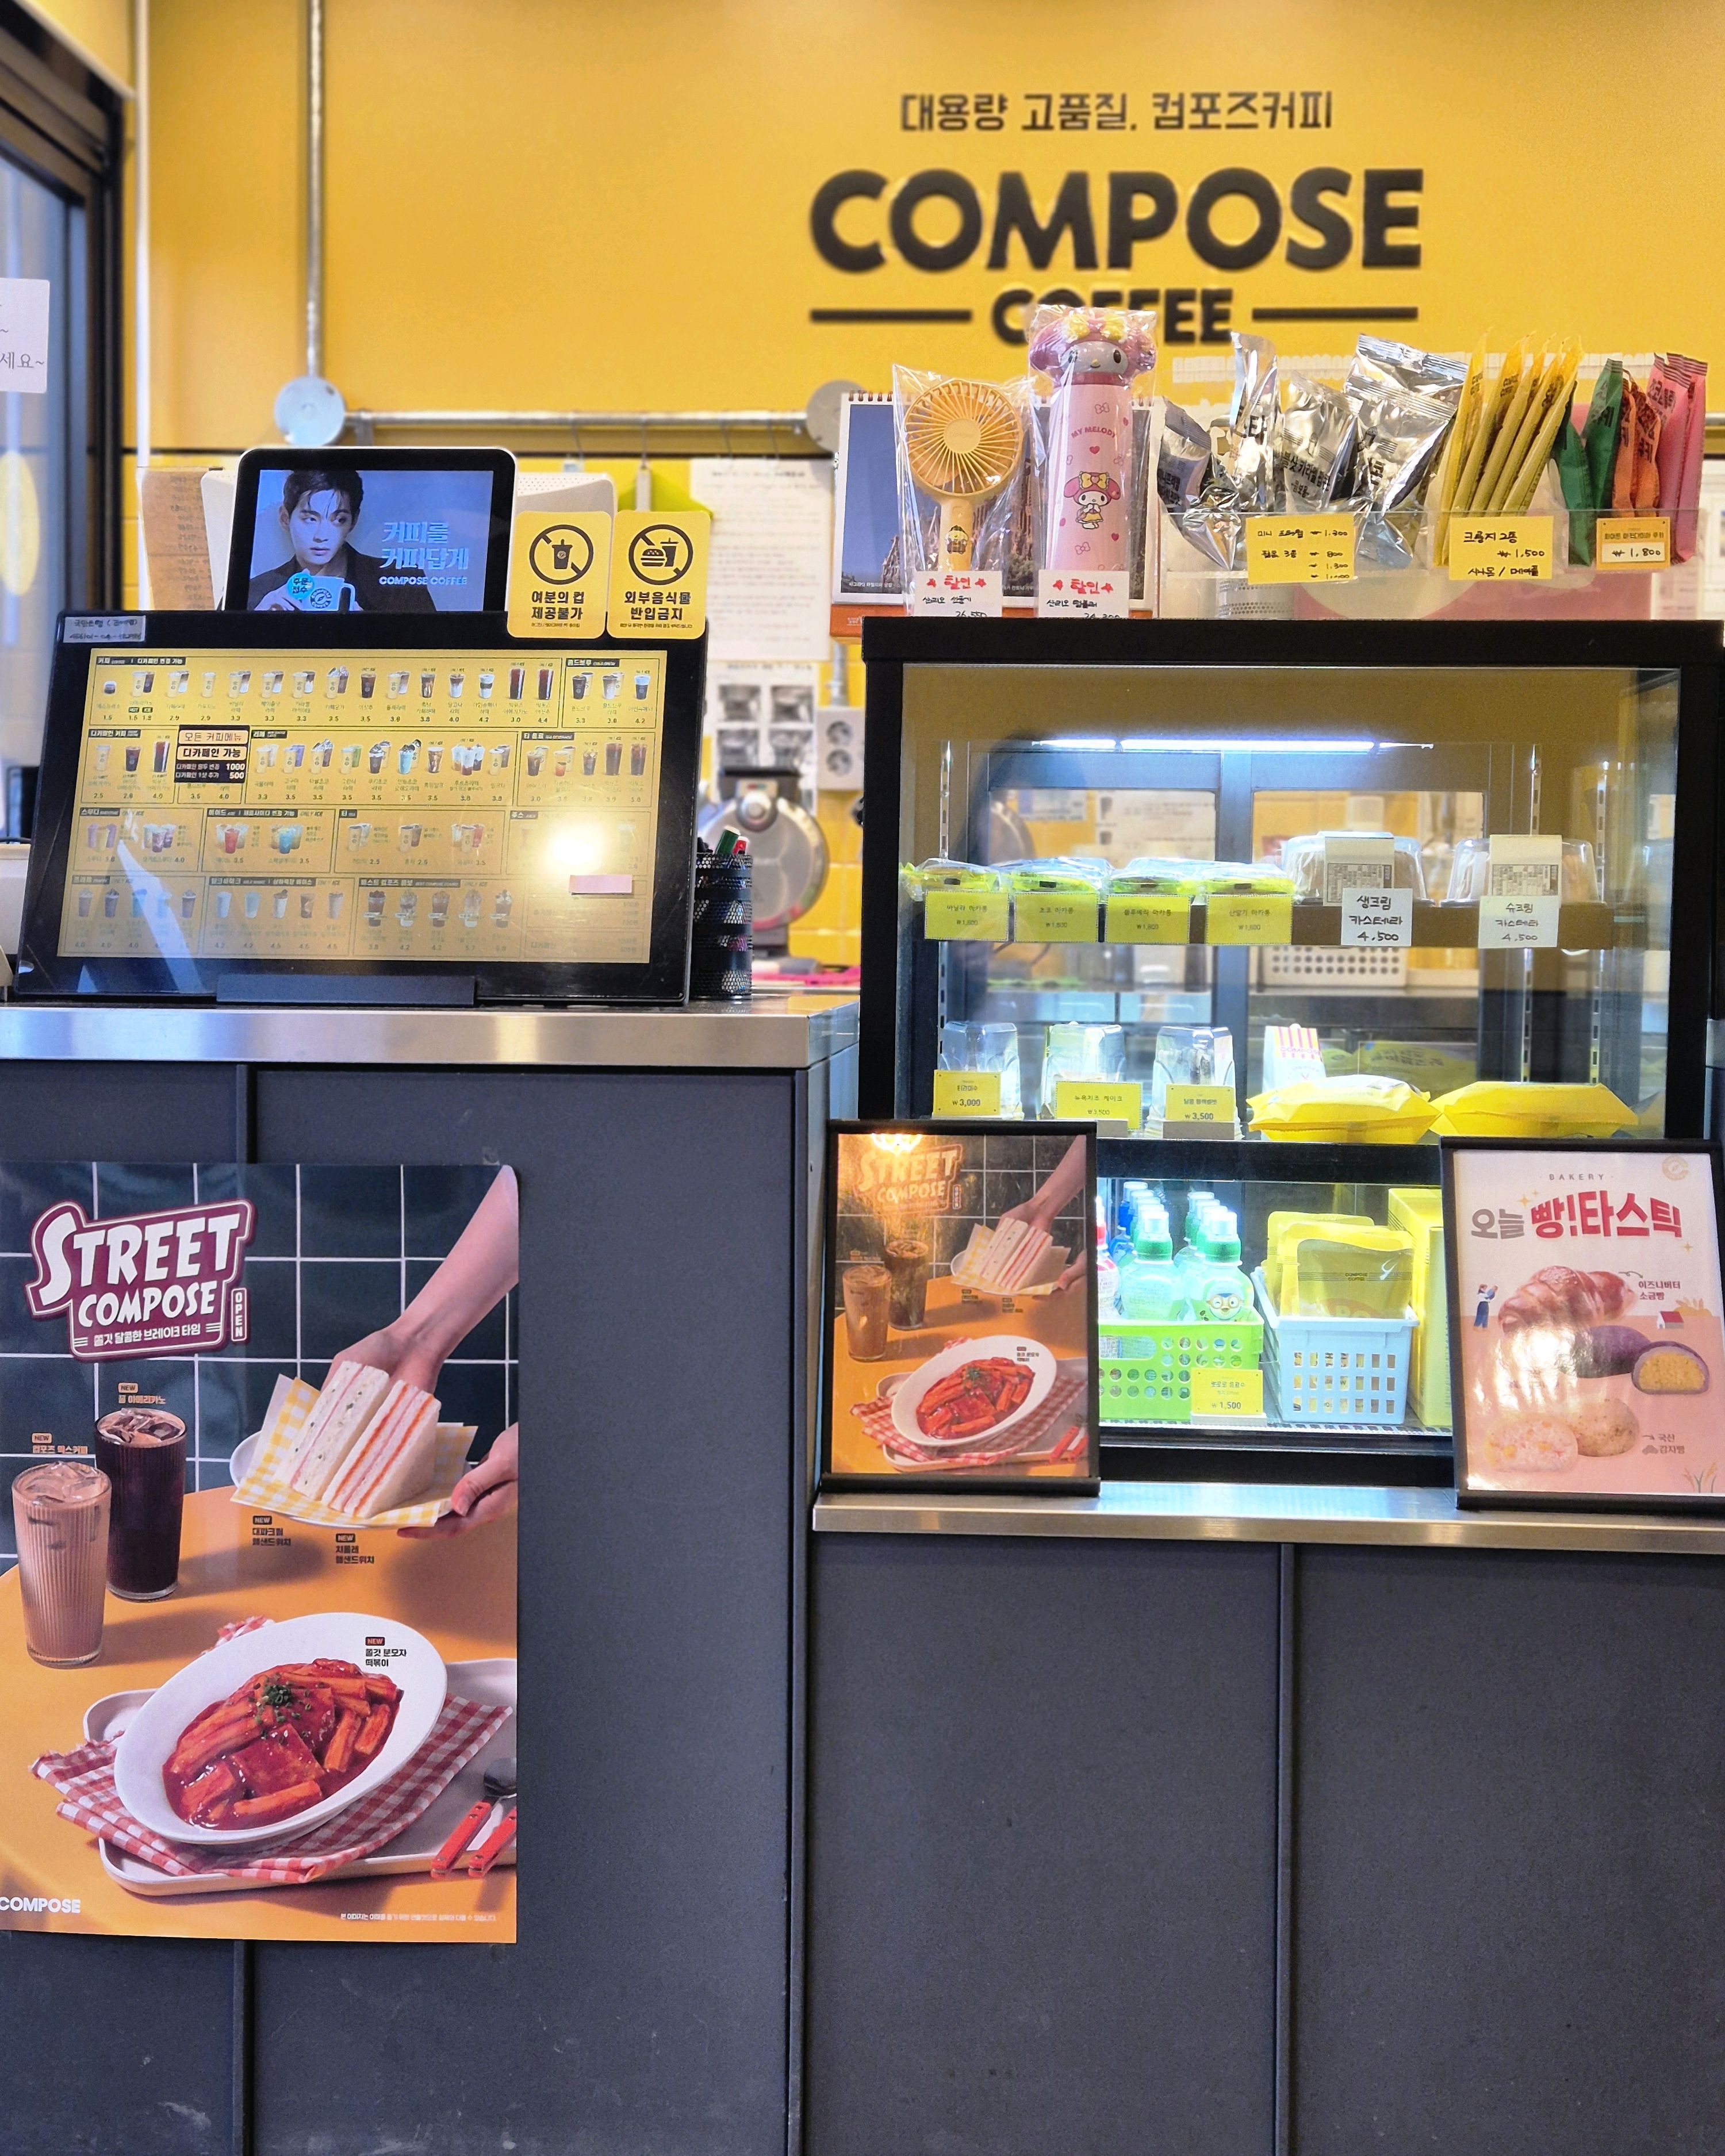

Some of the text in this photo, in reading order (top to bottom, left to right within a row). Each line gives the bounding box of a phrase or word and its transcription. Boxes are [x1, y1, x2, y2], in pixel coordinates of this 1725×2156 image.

[900, 93, 1008, 132] 대용량
[1152, 92, 1332, 130] 컴포즈커피
[810, 167, 1423, 274] COMPOSE
[1071, 425, 1117, 439] MY MELODY
[382, 521, 448, 544] 커피를
[1463, 531, 1496, 543] 크룽지
[379, 547, 469, 570] 커피답게
[379, 576, 467, 585] COMPOSE COFFEE
[944, 575, 971, 590] 할인
[1071, 578, 1101, 594] 할인
[531, 590, 585, 604] 여분의 컵
[624, 590, 692, 605] 외부음식물
[531, 607, 583, 620] 제공불가
[631, 607, 683, 620] 반입금지
[185, 732, 241, 742] 모든 커피메뉴
[183, 748, 241, 758] 디카페인 가능
[1357, 895, 1392, 911] 생크림
[1505, 902, 1534, 914] 슈크림
[1348, 915, 1403, 926] 카스테라
[1357, 930, 1400, 942] 4,500
[858, 1150, 957, 1192] STREET
[877, 1180, 946, 1203] COMPOSE
[1471, 1190, 1682, 1239] 오늘 빵!타스틱
[39, 1212, 240, 1306] STREET
[1638, 1280, 1681, 1290] 이즈니버터
[1640, 1291, 1665, 1300] 소금빵
[78, 1281, 217, 1328] COMPOSE
[234, 1291, 243, 1337] OPEN
[94, 1323, 201, 1347] 쫄깃 달콤한 브레이크 타임
[128, 1395, 166, 1405] 아메리카노
[1658, 1433, 1675, 1443] 국산
[252, 1528, 283, 1536] 대파크림
[384, 1648, 407, 1657] 분모자
[366, 1659, 389, 1667] 떡볶이
[0, 1897, 81, 1914] COMPOSE
